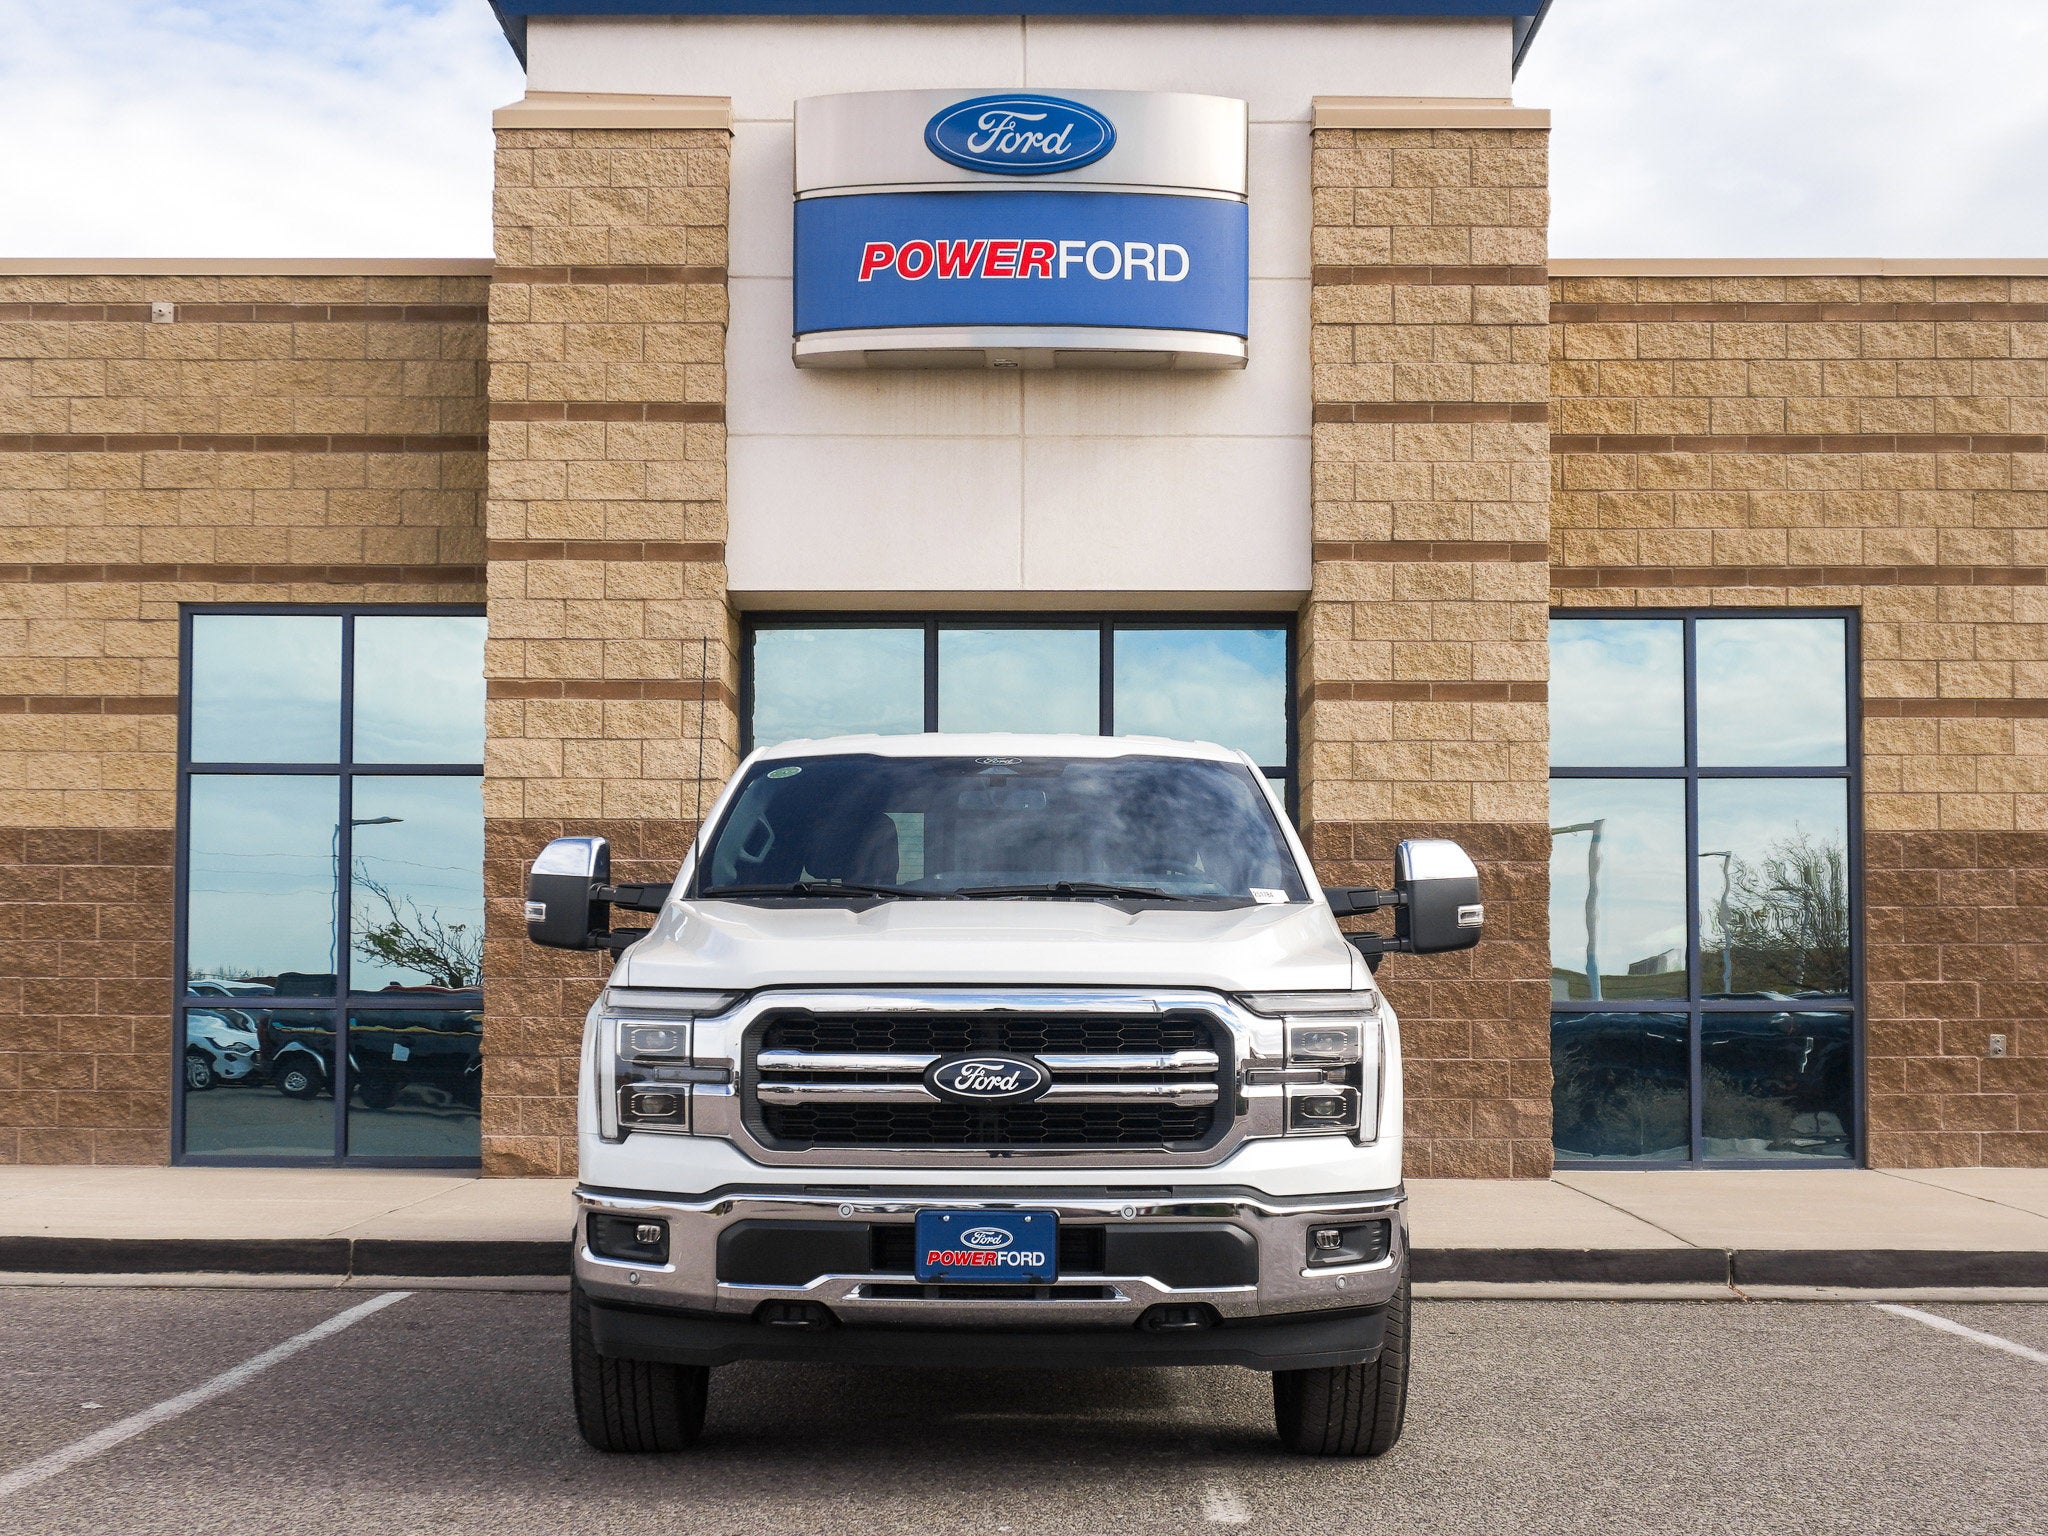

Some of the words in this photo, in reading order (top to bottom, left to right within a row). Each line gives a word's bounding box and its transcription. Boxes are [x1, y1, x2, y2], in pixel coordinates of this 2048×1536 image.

[967, 110, 1074, 154] Ford
[954, 1063, 1021, 1090] Ford
[971, 1231, 1002, 1245] Ford
